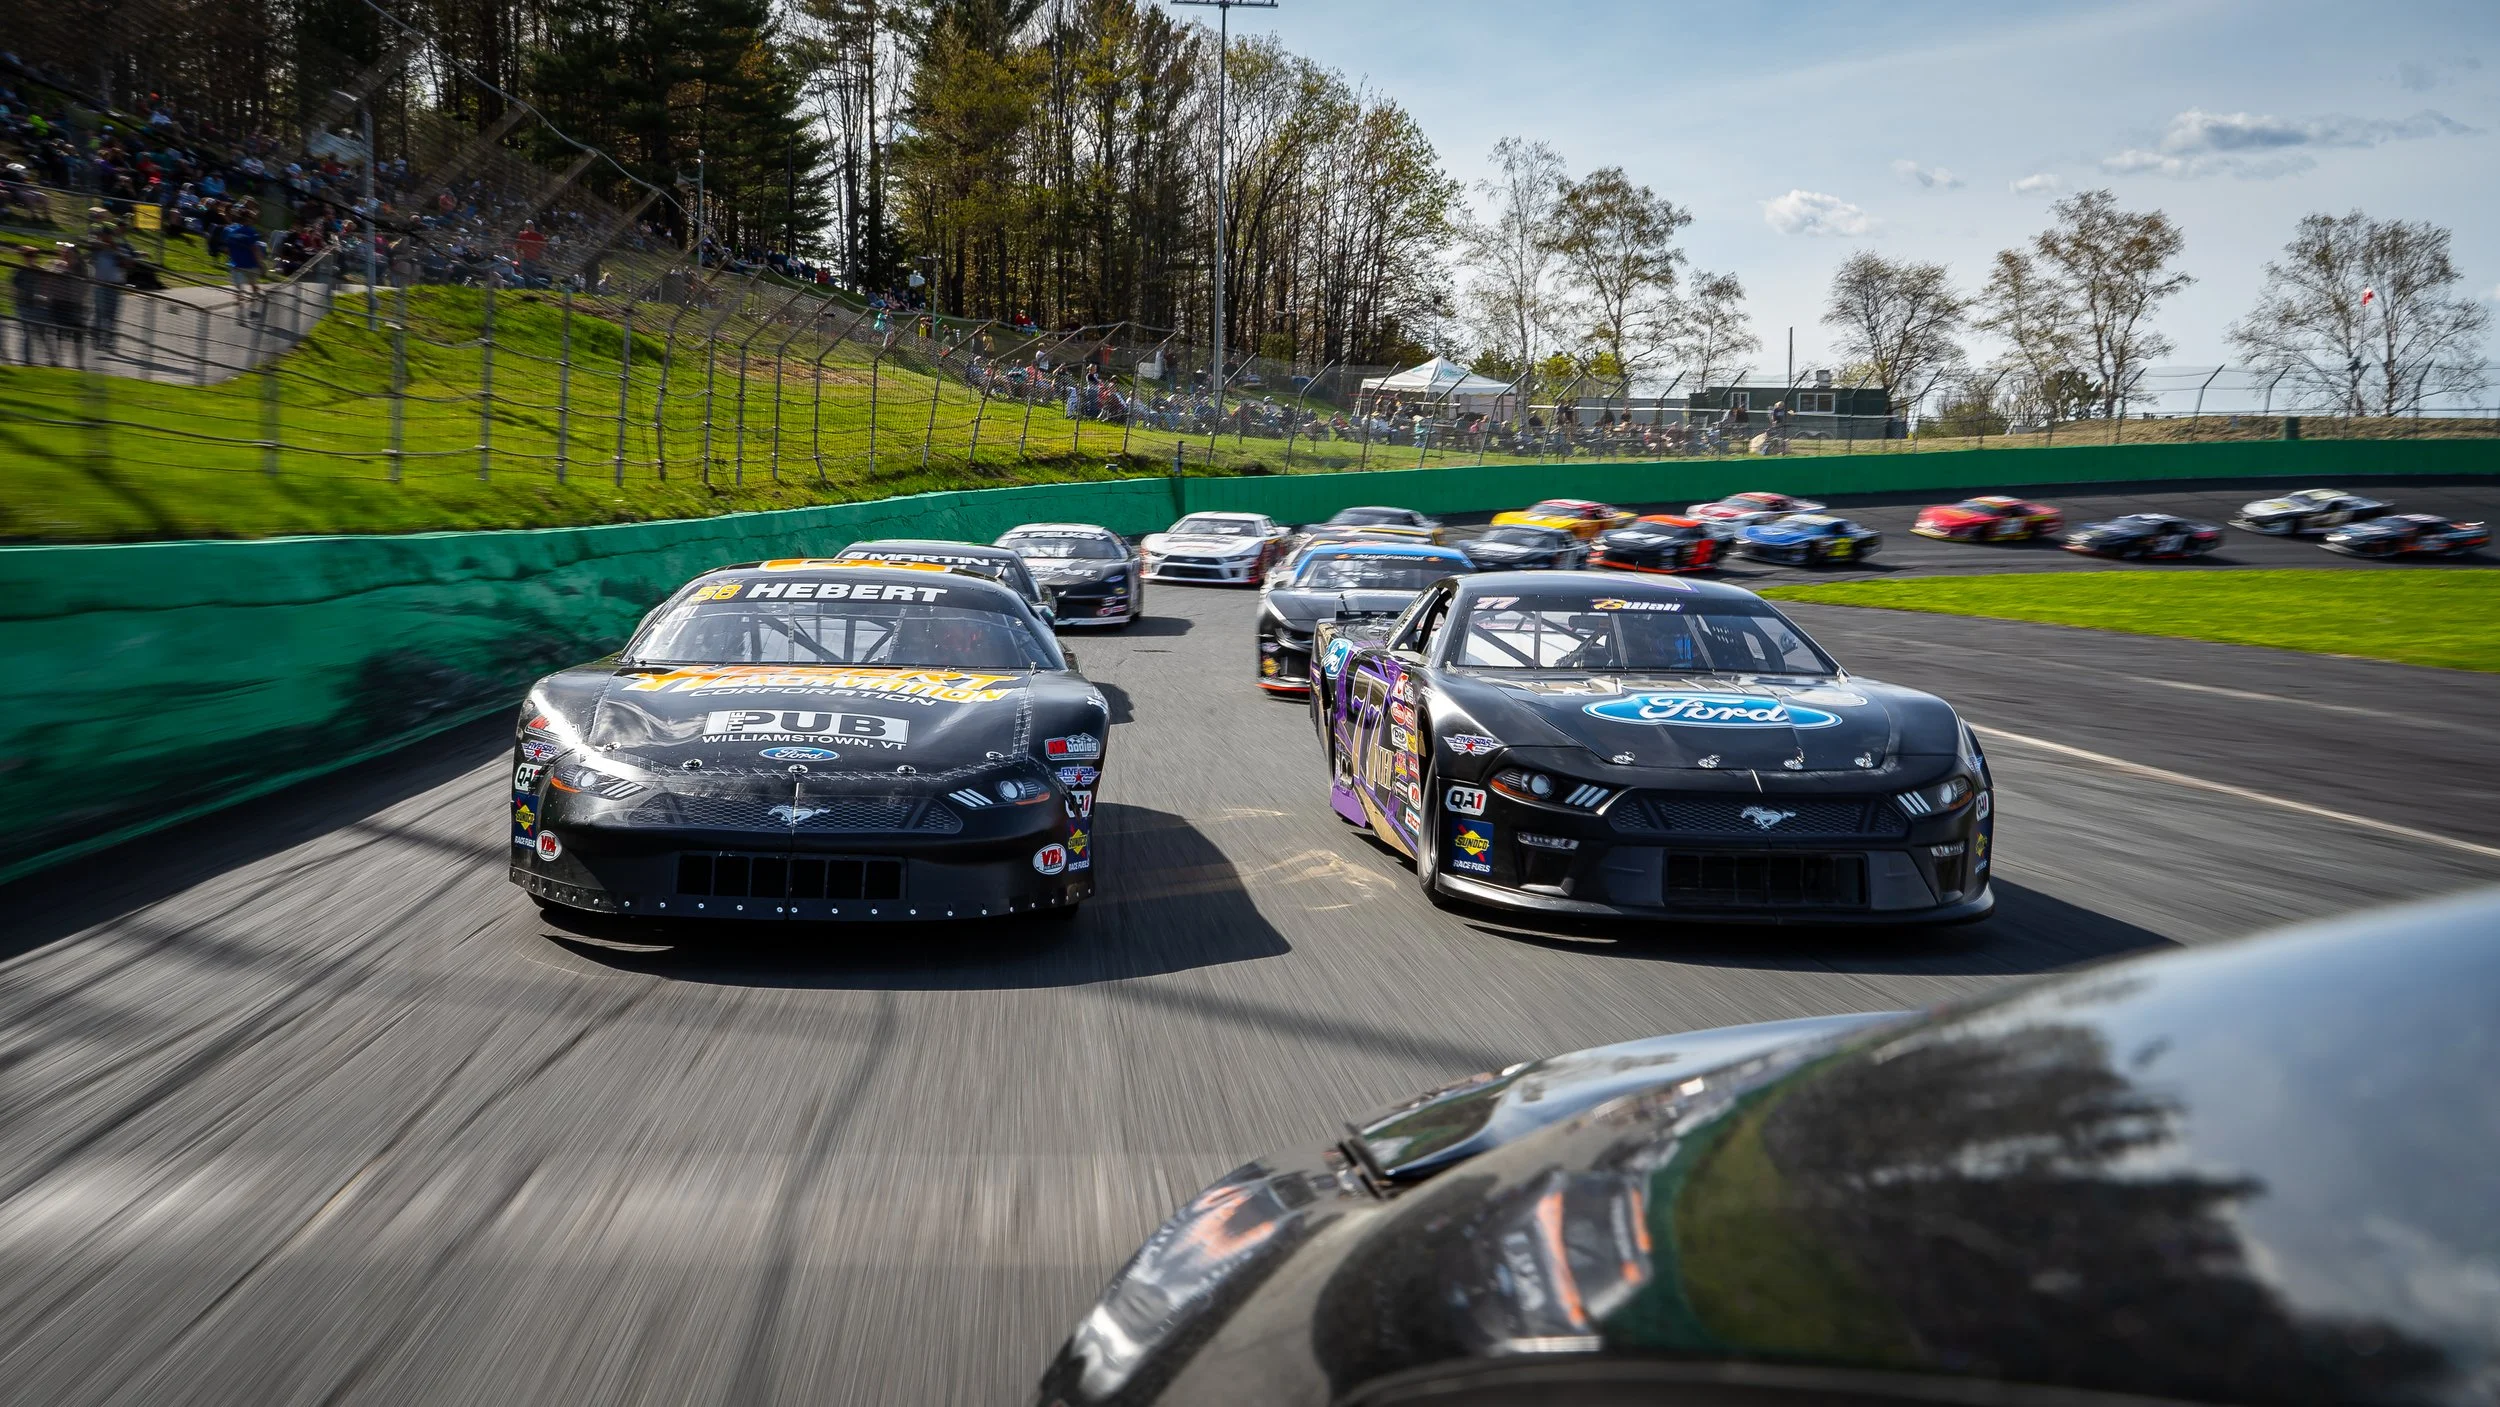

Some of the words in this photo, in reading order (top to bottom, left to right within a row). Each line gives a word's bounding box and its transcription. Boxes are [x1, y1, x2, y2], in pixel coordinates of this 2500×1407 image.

[867, 552, 989, 566] MARTIN
[692, 585, 743, 600] 58
[745, 583, 948, 602] HEBERT
[1474, 597, 1520, 609] 77
[690, 688, 937, 706] CORPORATION
[1639, 697, 1791, 723] Ford
[727, 712, 747, 732] THE
[727, 711, 886, 737] PUB
[702, 733, 874, 748] WILLIAMSTOWN,
[880, 742, 907, 750] VT
[774, 748, 822, 759] Ford
[1450, 789, 1484, 810] QA1
[1456, 835, 1490, 850] SUNOCO
[1453, 859, 1471, 870] RACE
[1471, 862, 1491, 873] FUELS
